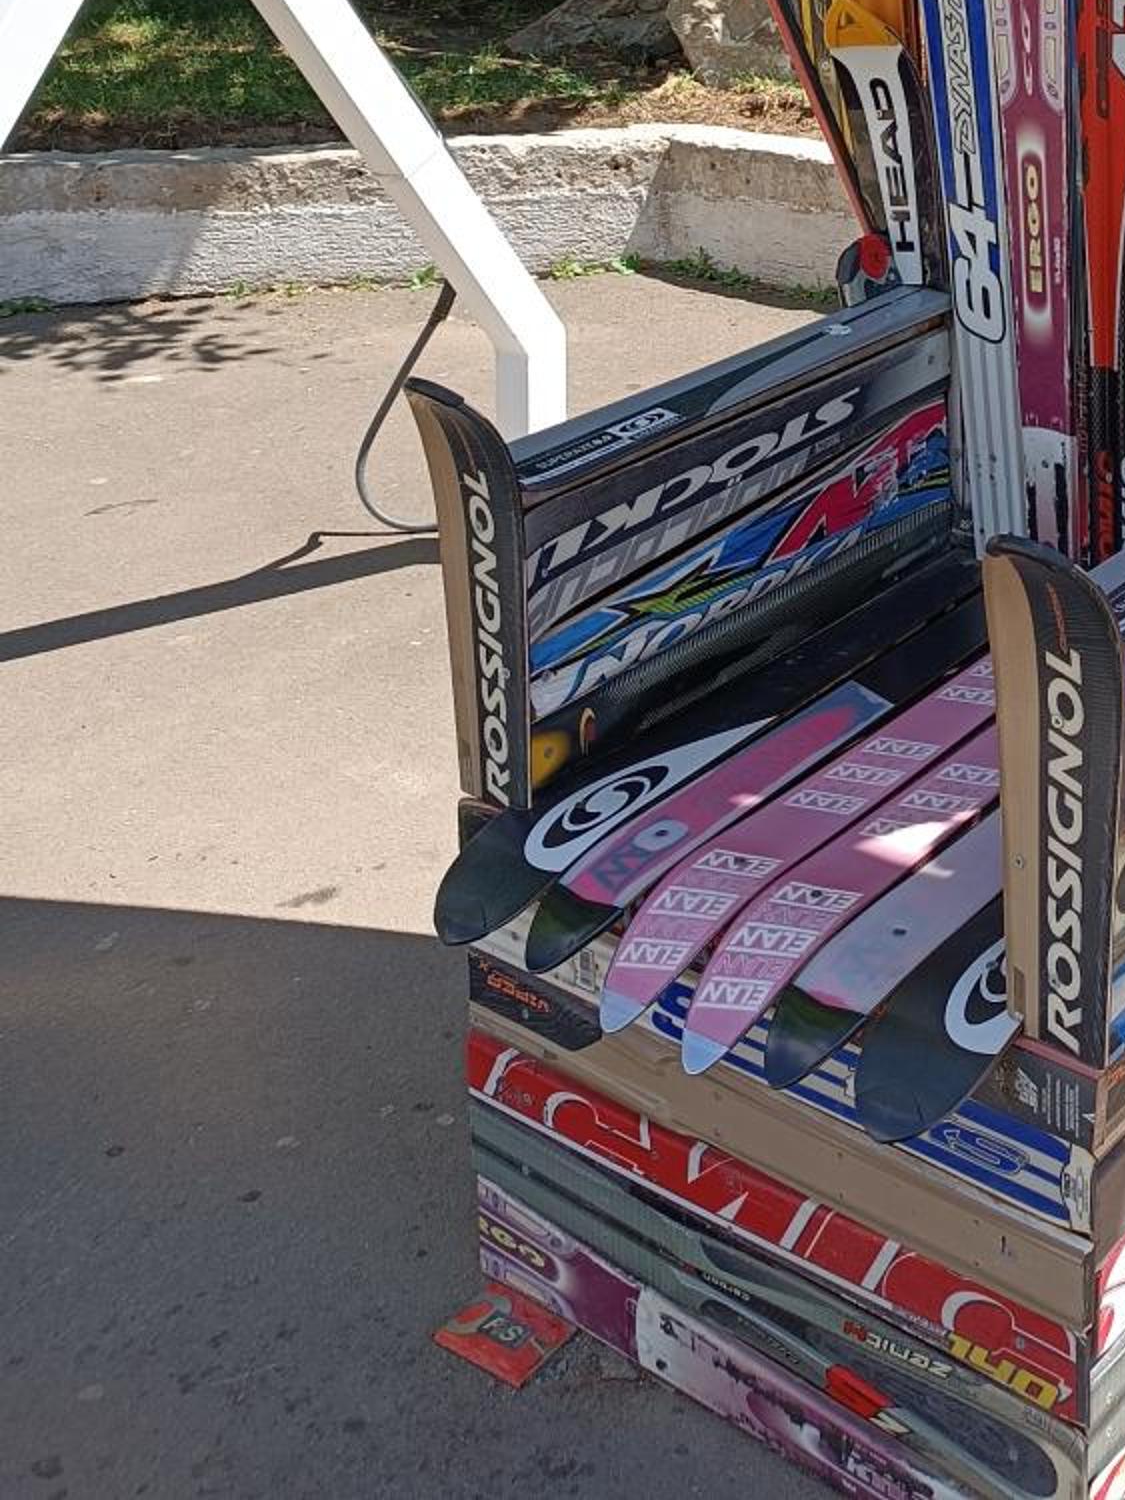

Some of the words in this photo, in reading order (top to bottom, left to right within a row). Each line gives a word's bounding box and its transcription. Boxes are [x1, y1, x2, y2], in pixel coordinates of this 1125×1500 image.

[866, 76, 915, 255] HEAD
[1023, 161, 1042, 294] ERGO
[950, 202, 1006, 345] 64
[460, 470, 510, 806] ROSSIGNOL
[698, 851, 779, 876] ELAN
[1044, 649, 1088, 1055] ROSSIGNOL
[652, 889, 733, 917] ELAN
[773, 884, 857, 910] ELAN
[617, 940, 688, 966] ELAN
[729, 925, 813, 954] ELAN
[700, 980, 770, 1008] ELAN
